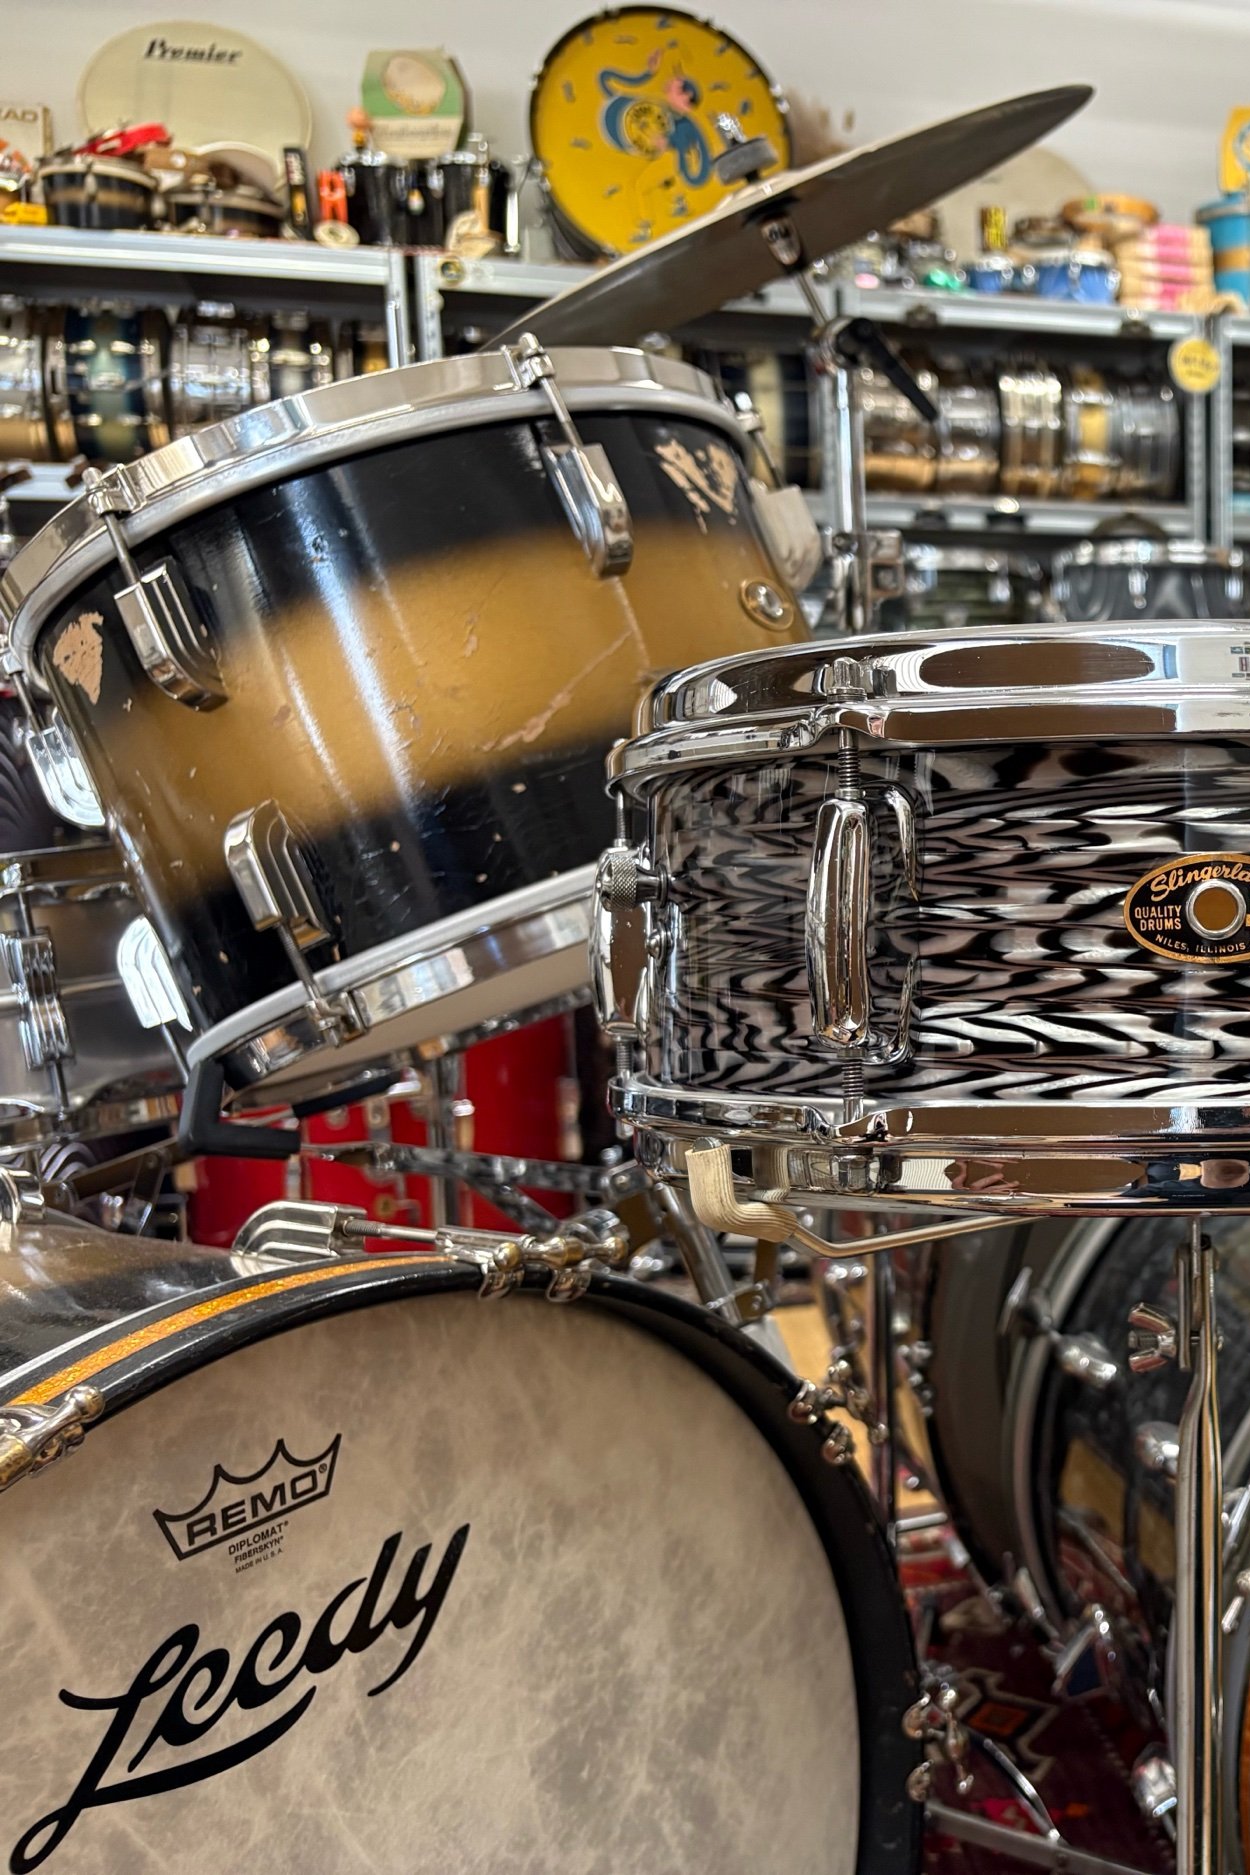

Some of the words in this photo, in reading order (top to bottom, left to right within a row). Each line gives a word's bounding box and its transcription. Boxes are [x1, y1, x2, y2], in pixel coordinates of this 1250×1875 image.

[1134, 904, 1182, 919] QUALITY
[1140, 918, 1182, 932] DRUMS
[1195, 942, 1246, 954] ILLINOIS
[9, 1522, 471, 1875] Leedy
